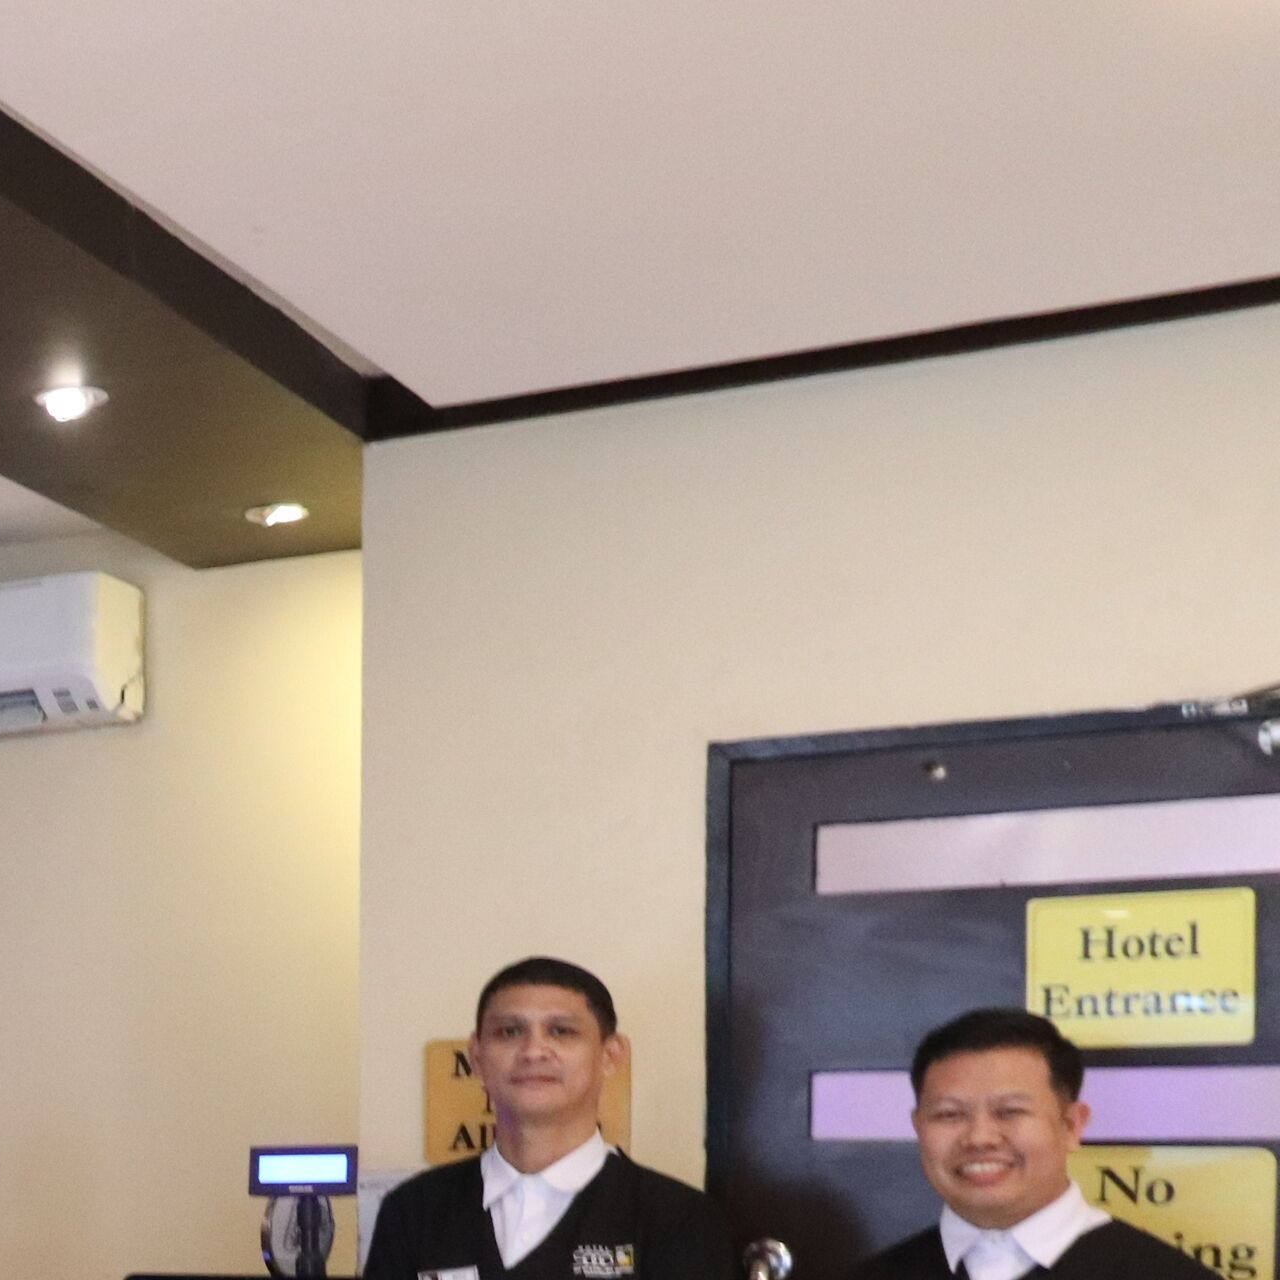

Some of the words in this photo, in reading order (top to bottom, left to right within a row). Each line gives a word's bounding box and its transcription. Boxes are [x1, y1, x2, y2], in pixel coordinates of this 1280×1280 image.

[1080, 919, 1200, 960] Hotel
[1041, 983, 1239, 1018] Entrance
[1097, 1166, 1175, 1206] No
